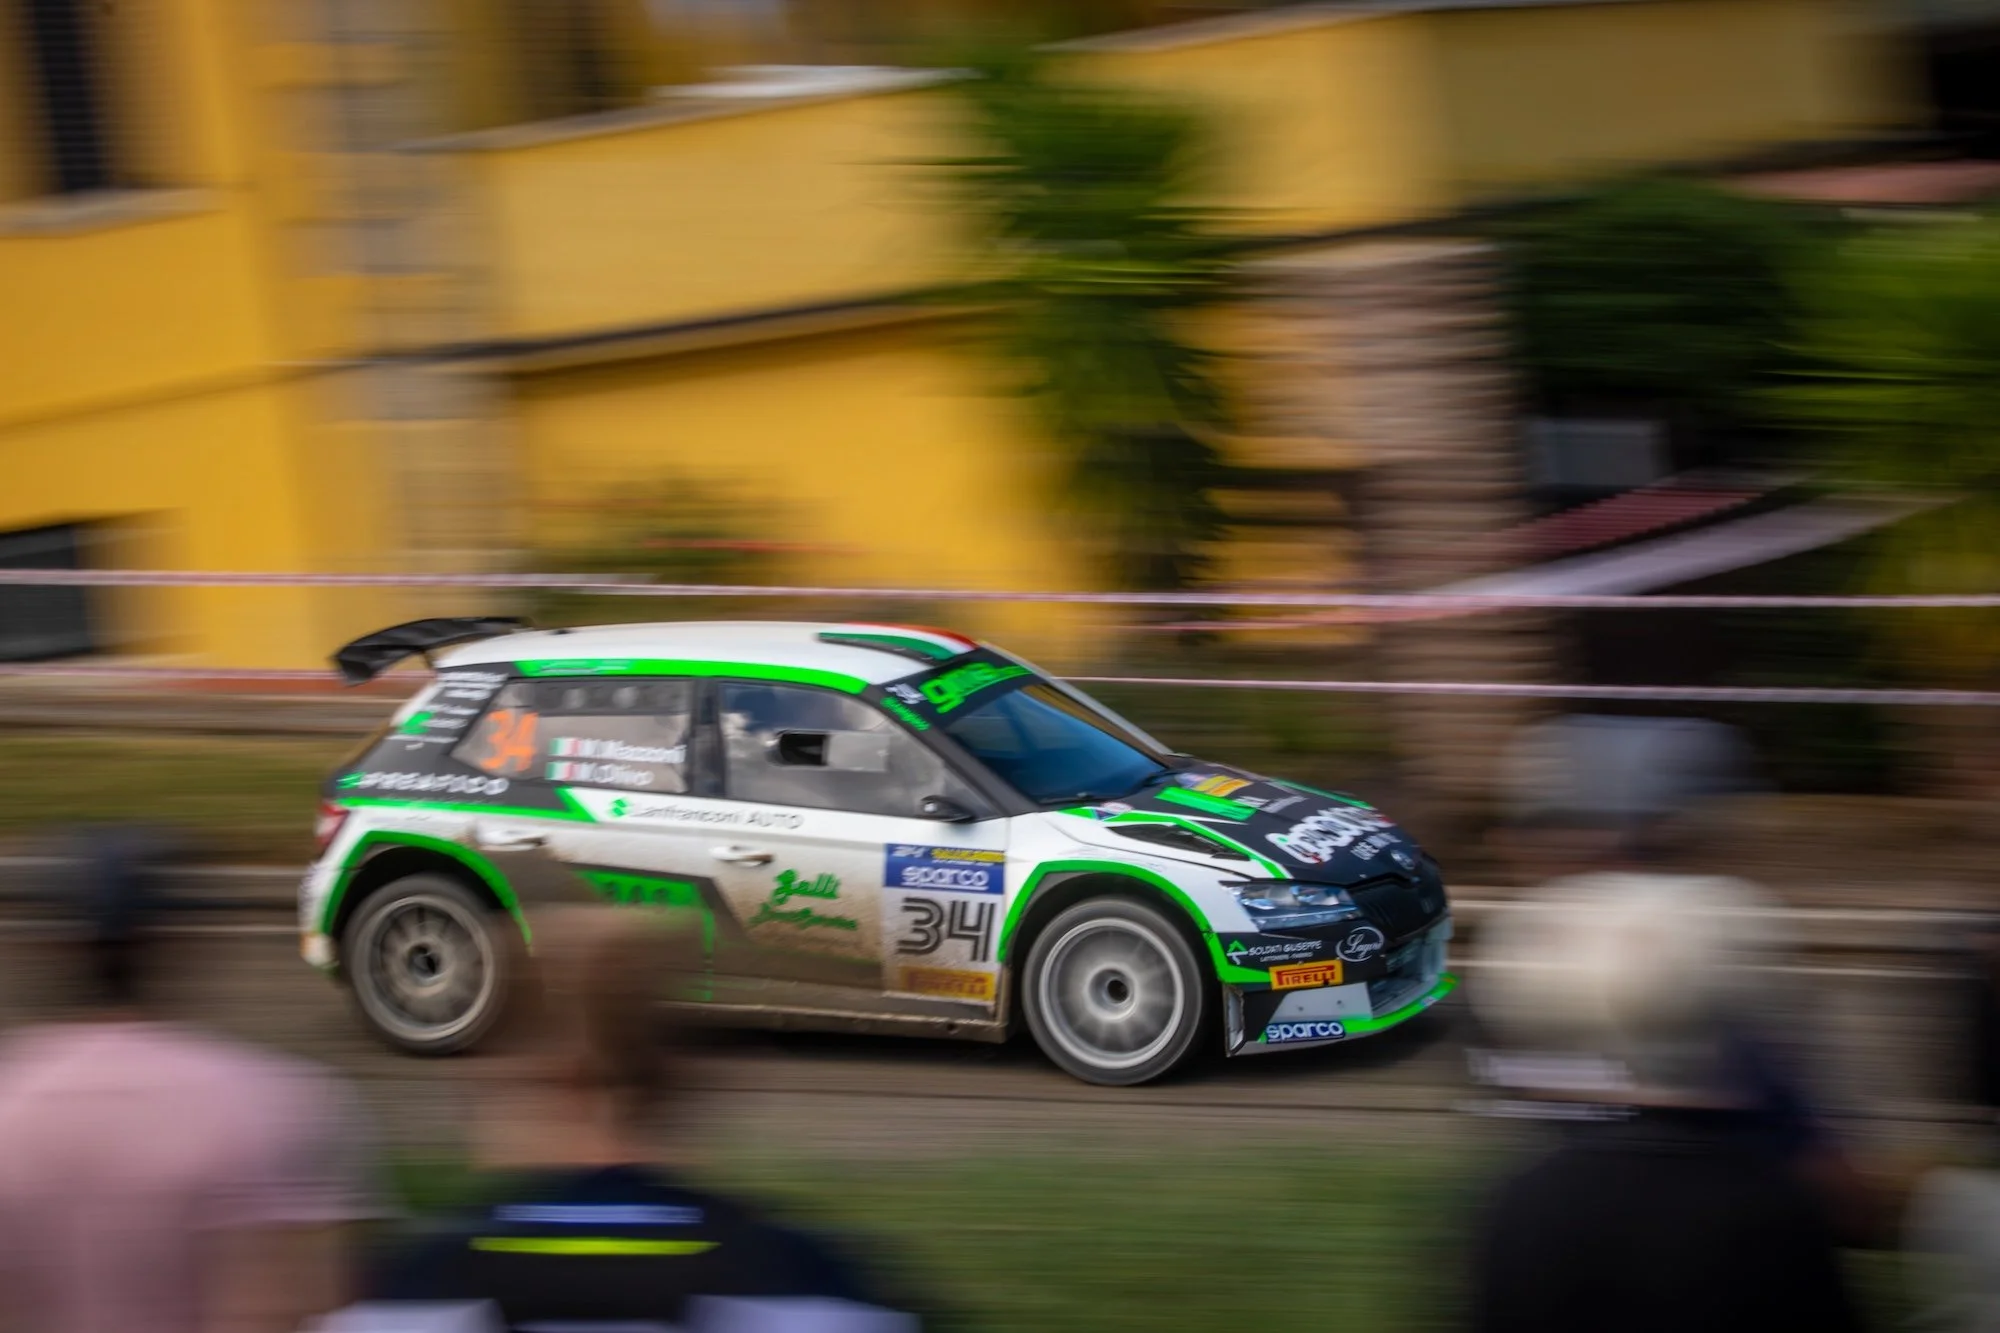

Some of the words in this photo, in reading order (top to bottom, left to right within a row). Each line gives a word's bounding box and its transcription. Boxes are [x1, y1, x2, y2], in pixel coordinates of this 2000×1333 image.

[479, 709, 537, 772] 34
[746, 808, 805, 830] AUTO
[901, 866, 990, 891] sparco
[897, 897, 995, 963] 34
[1249, 942, 1283, 956] SOLDATI
[1284, 939, 1322, 953] GIUSEPPE
[1276, 964, 1336, 986] PIRELLI
[1266, 1021, 1344, 1043] sparco
